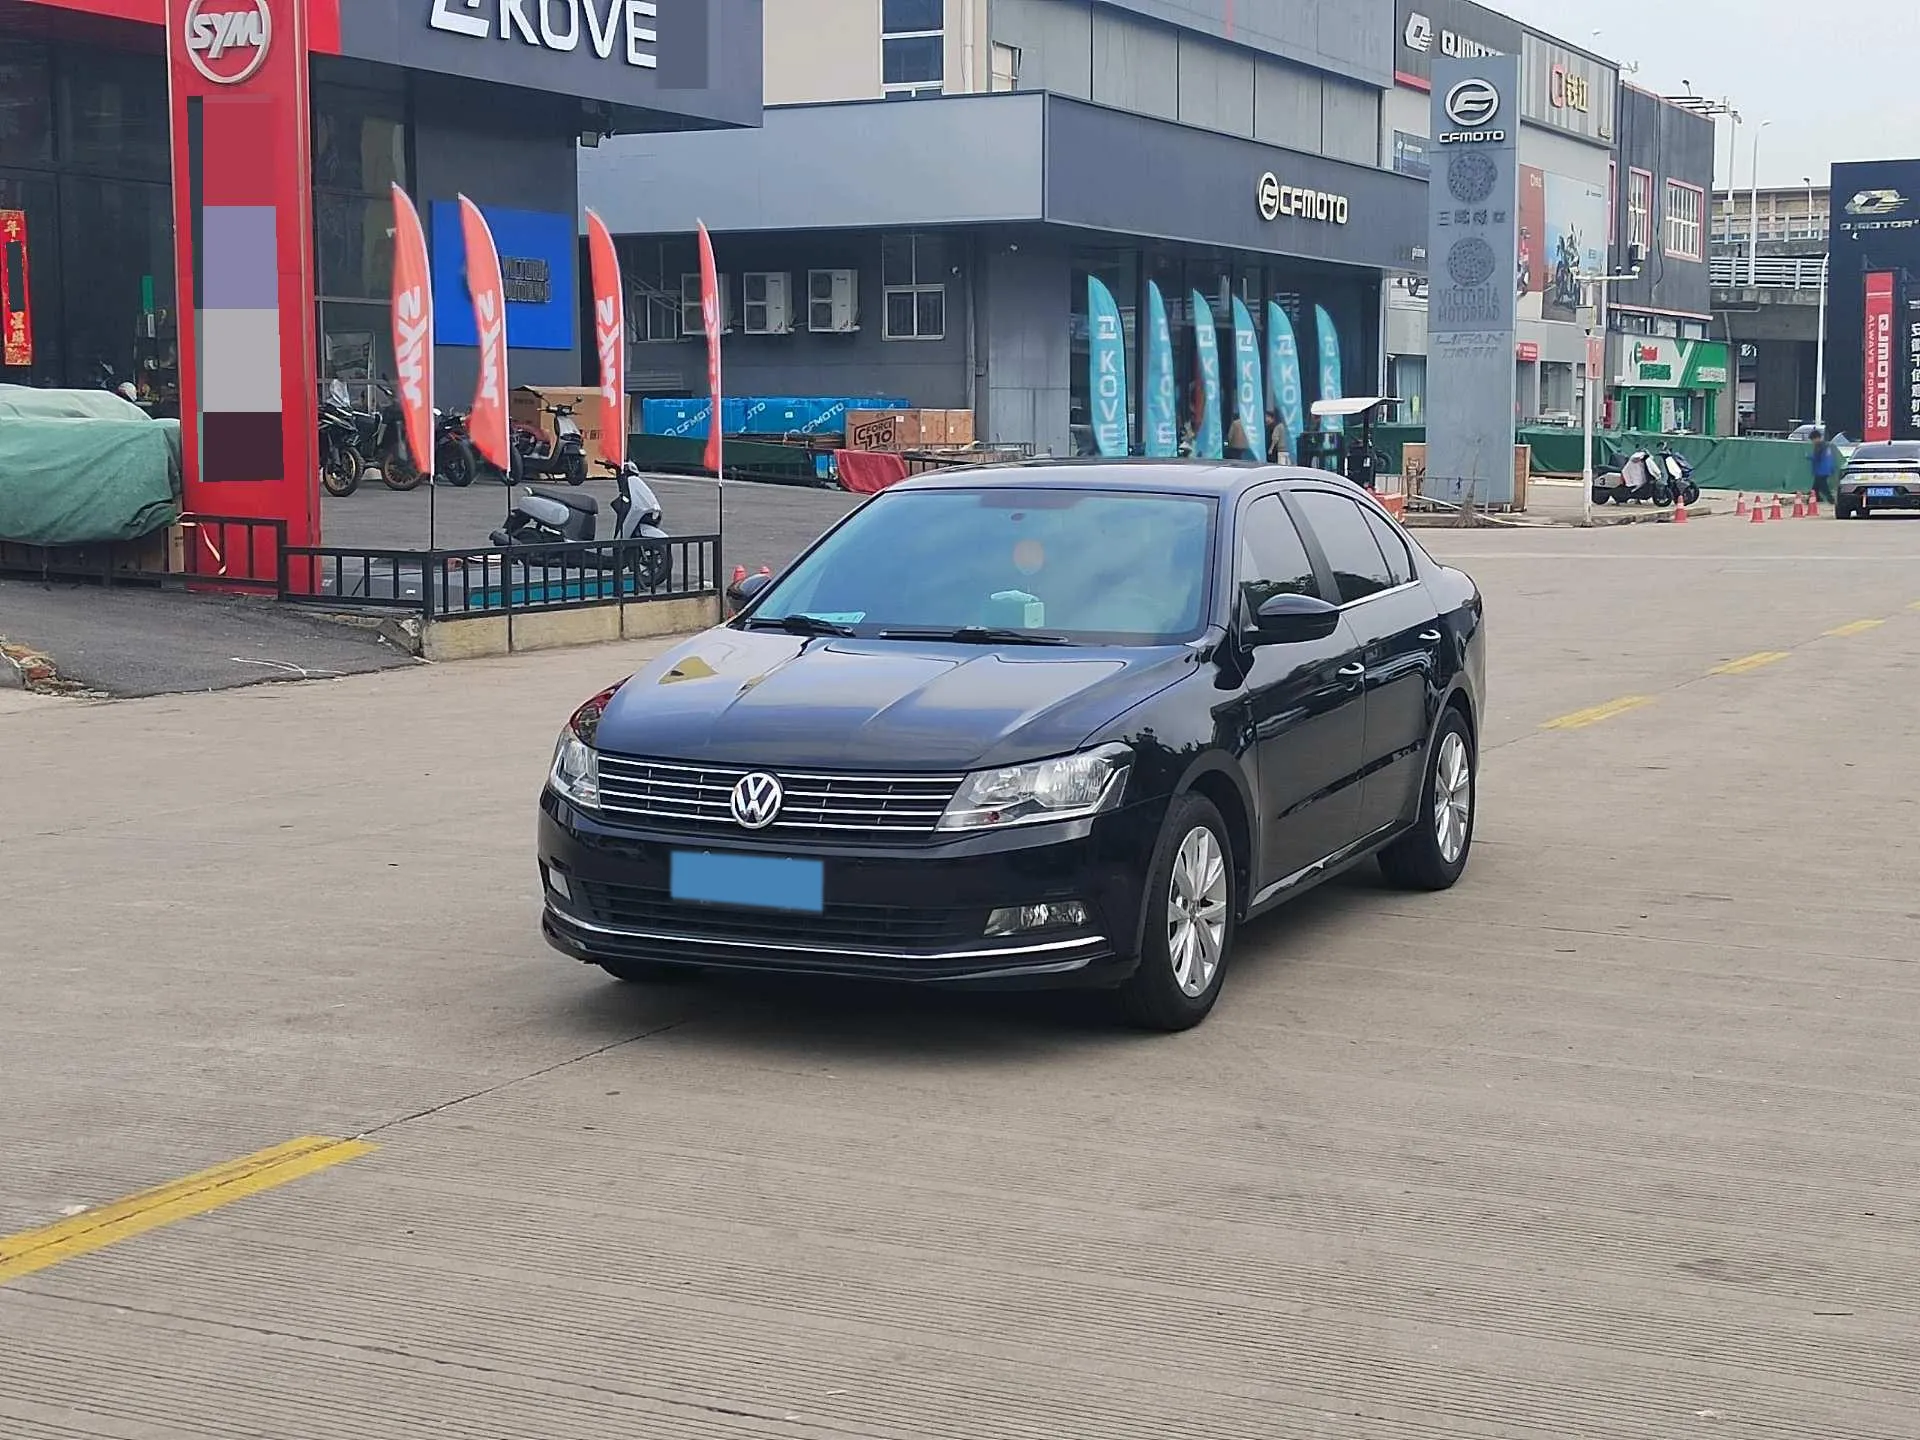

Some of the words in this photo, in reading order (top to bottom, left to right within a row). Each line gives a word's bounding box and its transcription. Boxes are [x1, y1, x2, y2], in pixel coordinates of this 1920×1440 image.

[190, 11, 264, 58] SYM
[1441, 30, 1504, 58] QJMO
[1439, 130, 1505, 143] CFMOTO
[1280, 185, 1348, 224] CFMOTO
[1877, 313, 1889, 428] QJMOTOR
[1100, 350, 1118, 447] KOVE
[676, 402, 713, 434] CFMOT
[801, 402, 844, 434] CFMOTO
